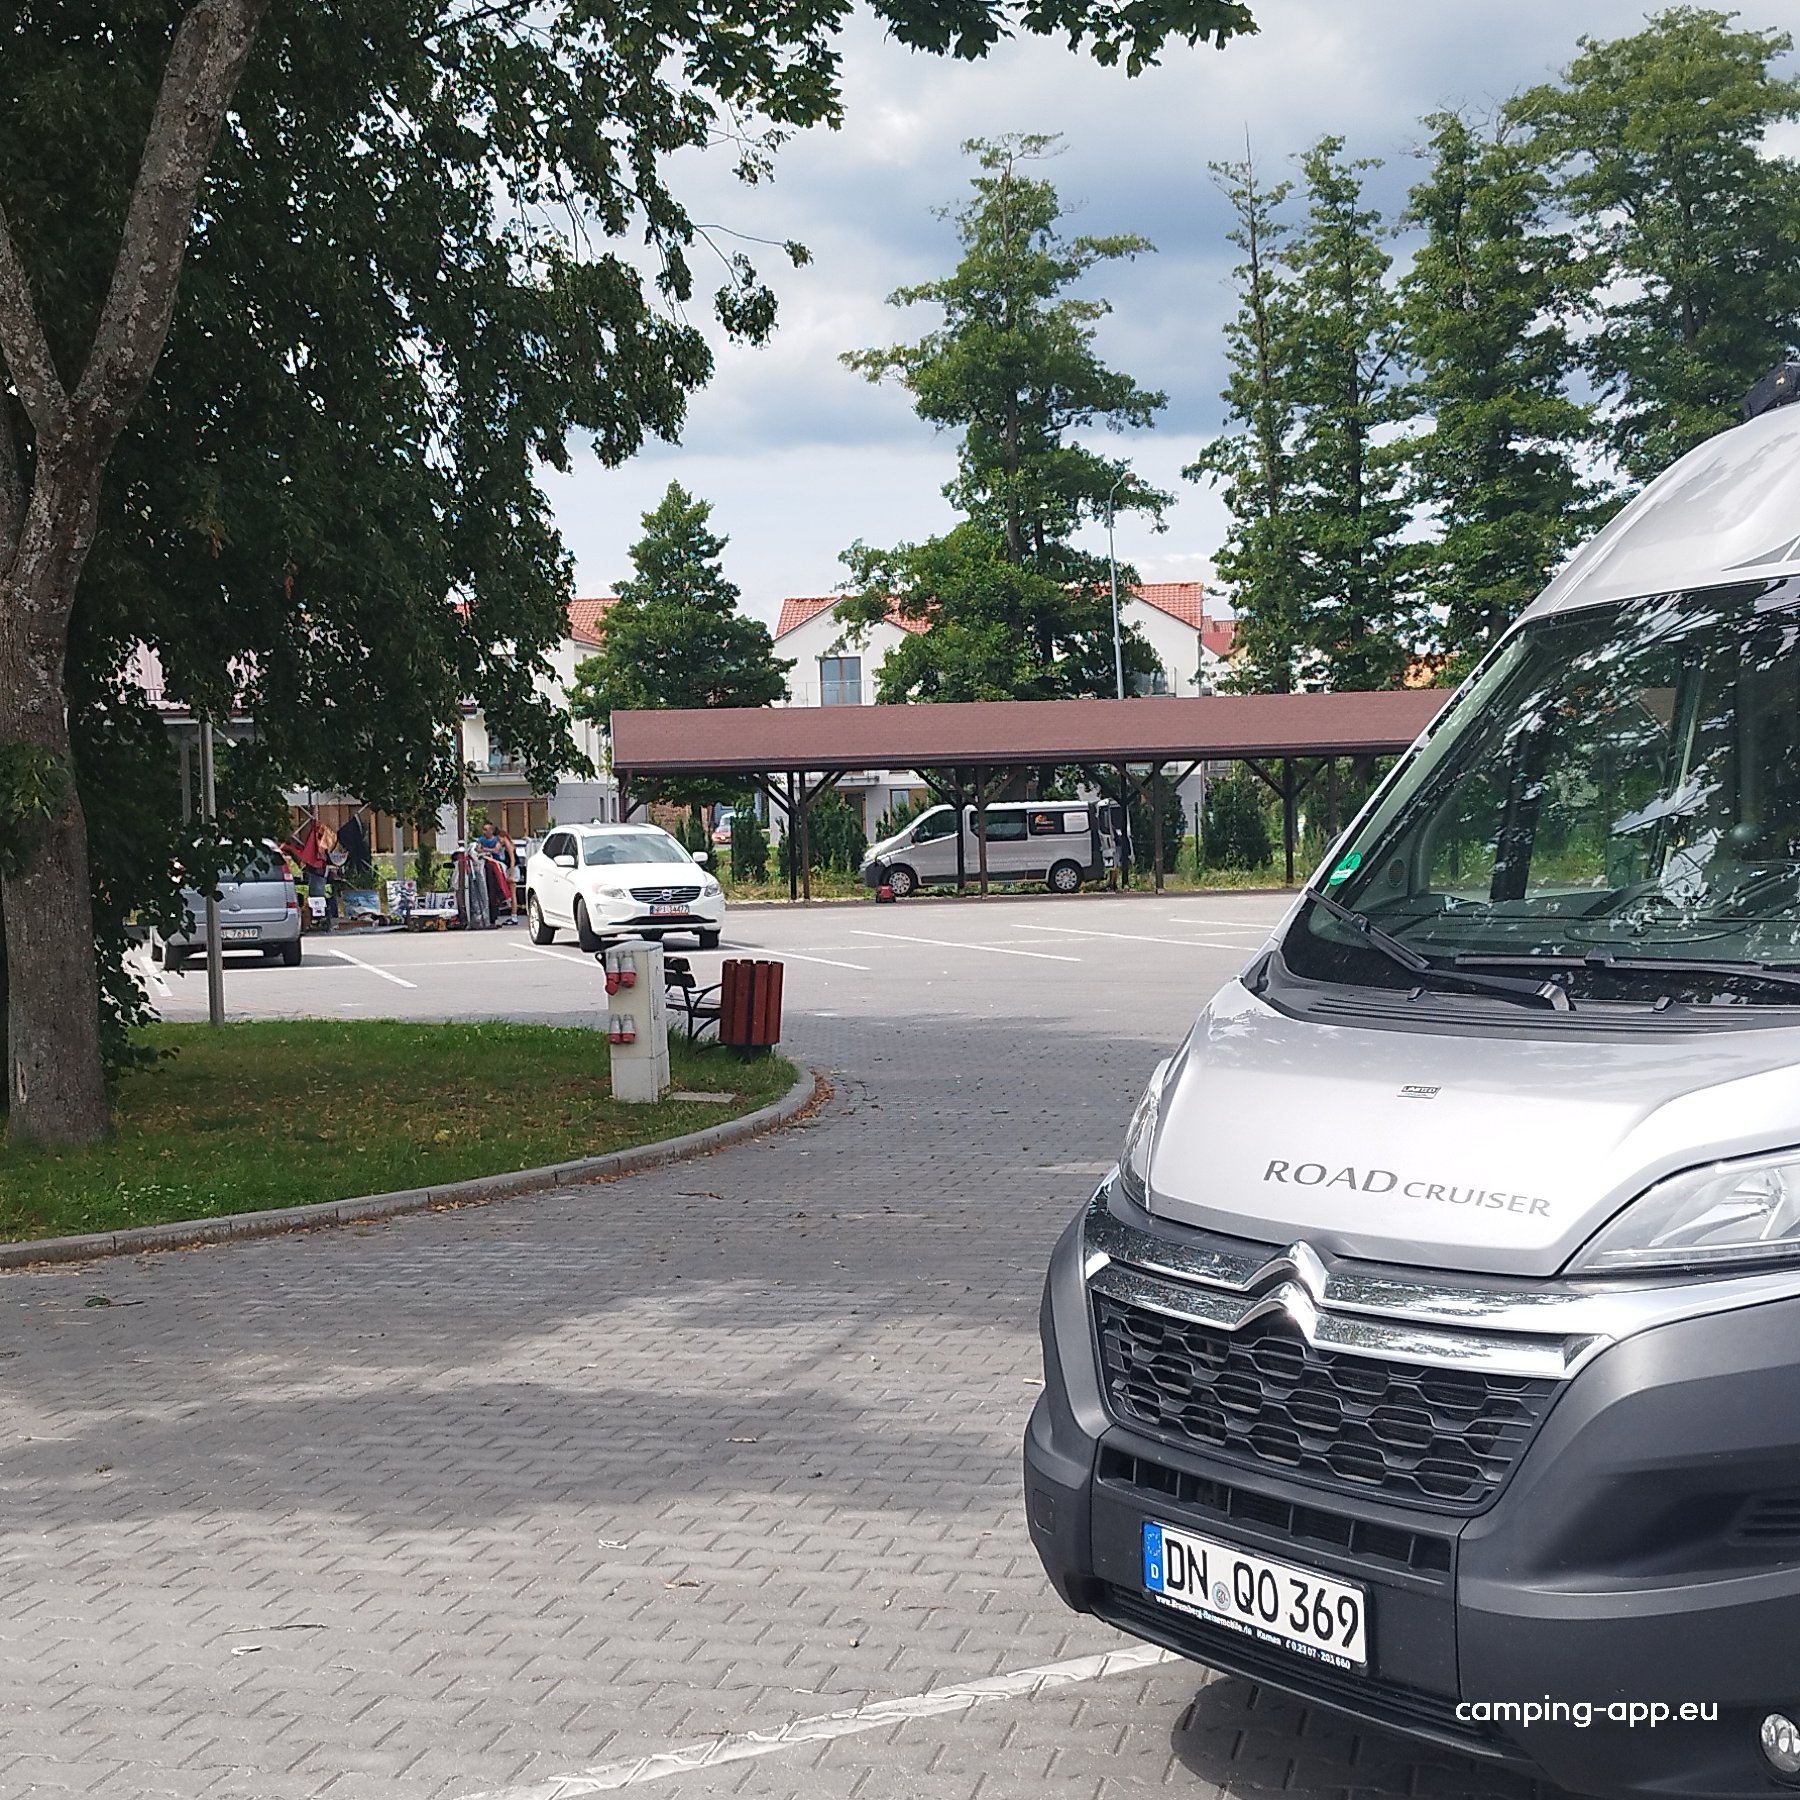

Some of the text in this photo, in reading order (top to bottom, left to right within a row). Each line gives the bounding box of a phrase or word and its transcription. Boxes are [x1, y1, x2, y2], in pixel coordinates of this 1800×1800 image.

[1263, 1159, 1551, 1217] ROAD CRUISER
[1150, 1563, 1159, 1579] D
[1165, 1537, 1359, 1649] DN QO 369
